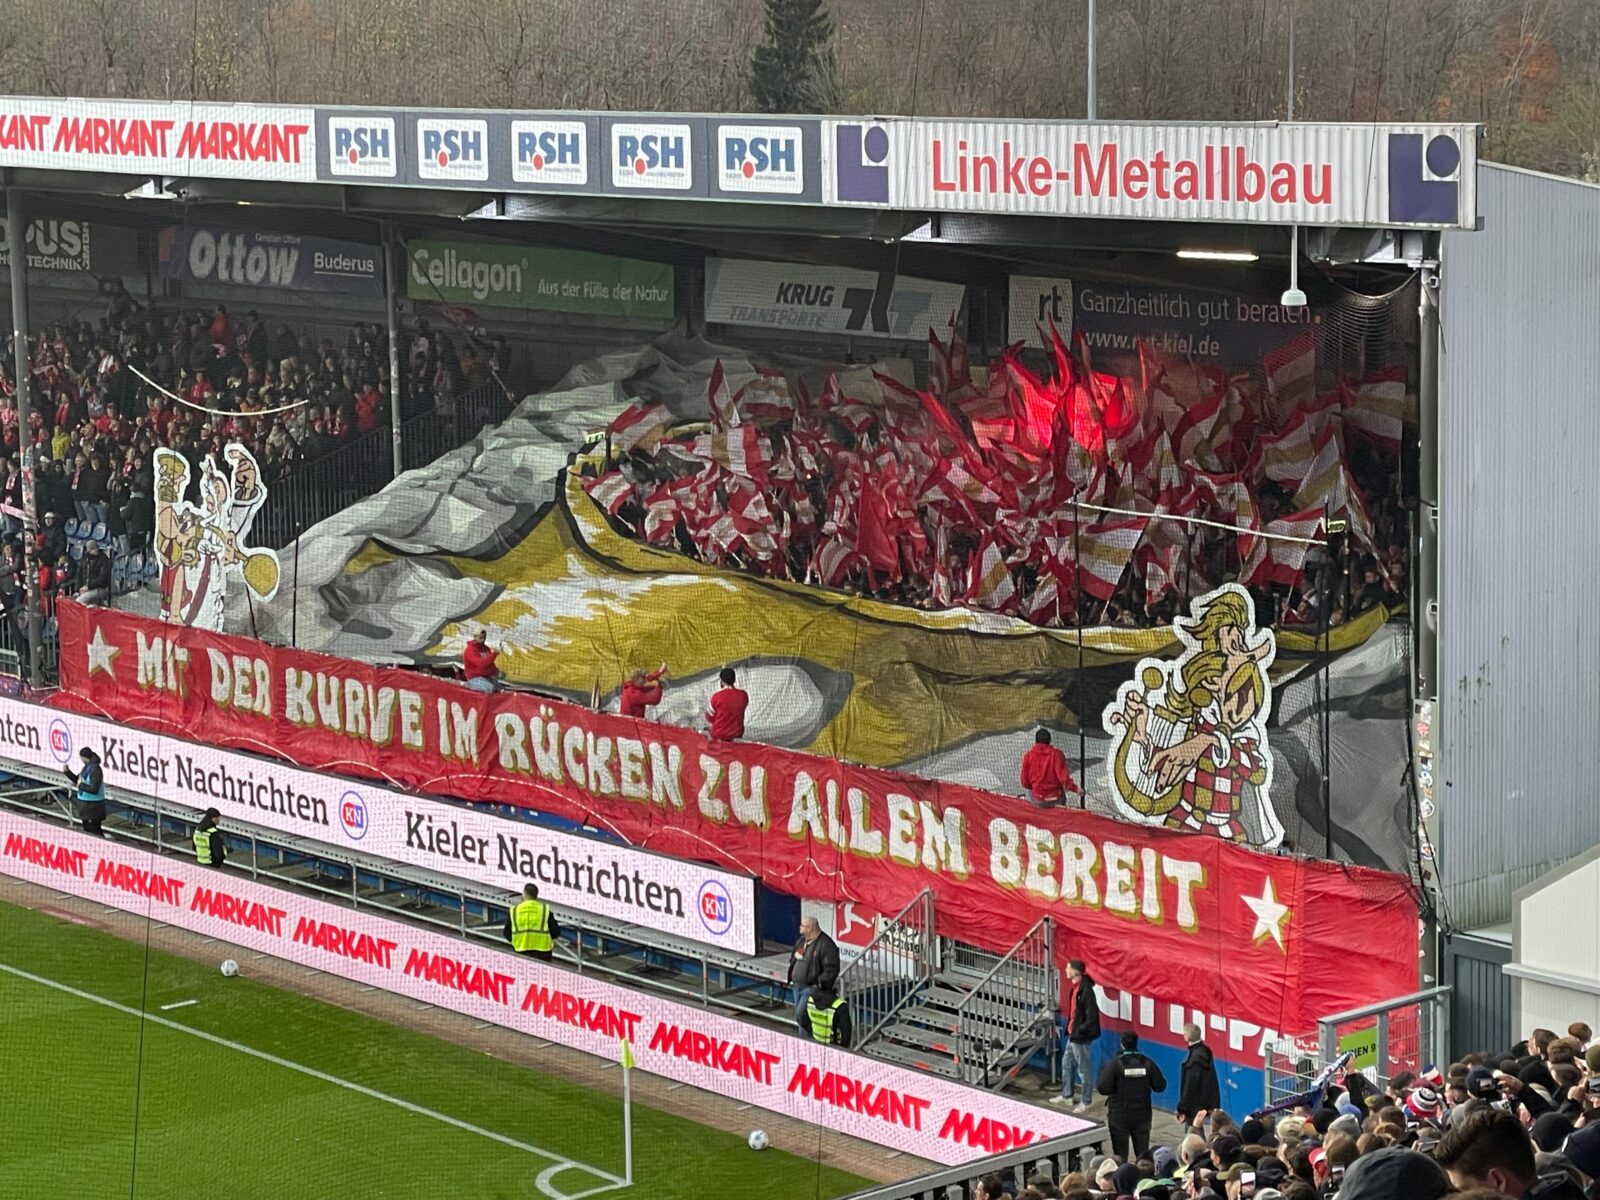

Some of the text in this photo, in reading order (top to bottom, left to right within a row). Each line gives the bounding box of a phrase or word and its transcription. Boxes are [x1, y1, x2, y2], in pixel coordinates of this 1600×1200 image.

[53, 117, 174, 157] MARKANT
[176, 121, 309, 163] MARKANT
[335, 127, 389, 158] RSH
[424, 129, 481, 161] RSH
[518, 132, 579, 164] RSH
[619, 135, 684, 168] RSH
[725, 137, 795, 172] RSH
[932, 140, 1332, 204] Linke-Metallbau
[189, 230, 299, 286] Ottow
[314, 252, 375, 273] Buderus
[538, 279, 559, 296] Aus
[561, 280, 581, 298] der
[612, 283, 633, 301] der
[635, 285, 670, 302] Natur
[776, 282, 835, 307] KRUG
[1039, 284, 1062, 322] rt
[1080, 289, 1190, 318] Ganzheitlich
[1198, 298, 1230, 326] gut
[101, 736, 330, 826] Kieler Nachrichten
[136, 631, 1205, 932] MIT DER KURVE IM RÜCKEN ZU ALLEM BEREIT
[342, 803, 364, 829] KN
[404, 810, 685, 918] Kieler Nachrichten
[702, 891, 728, 922] KN
[4, 831, 88, 878] MARKANT
[94, 859, 185, 907] MARKANT
[190, 886, 287, 937] MARKANT
[293, 916, 398, 969] MARKANT
[403, 948, 516, 1006] MARKANT
[520, 984, 643, 1044] MARKANT
[648, 1021, 781, 1086] MARKANT
[787, 1063, 932, 1132] MARKANT
